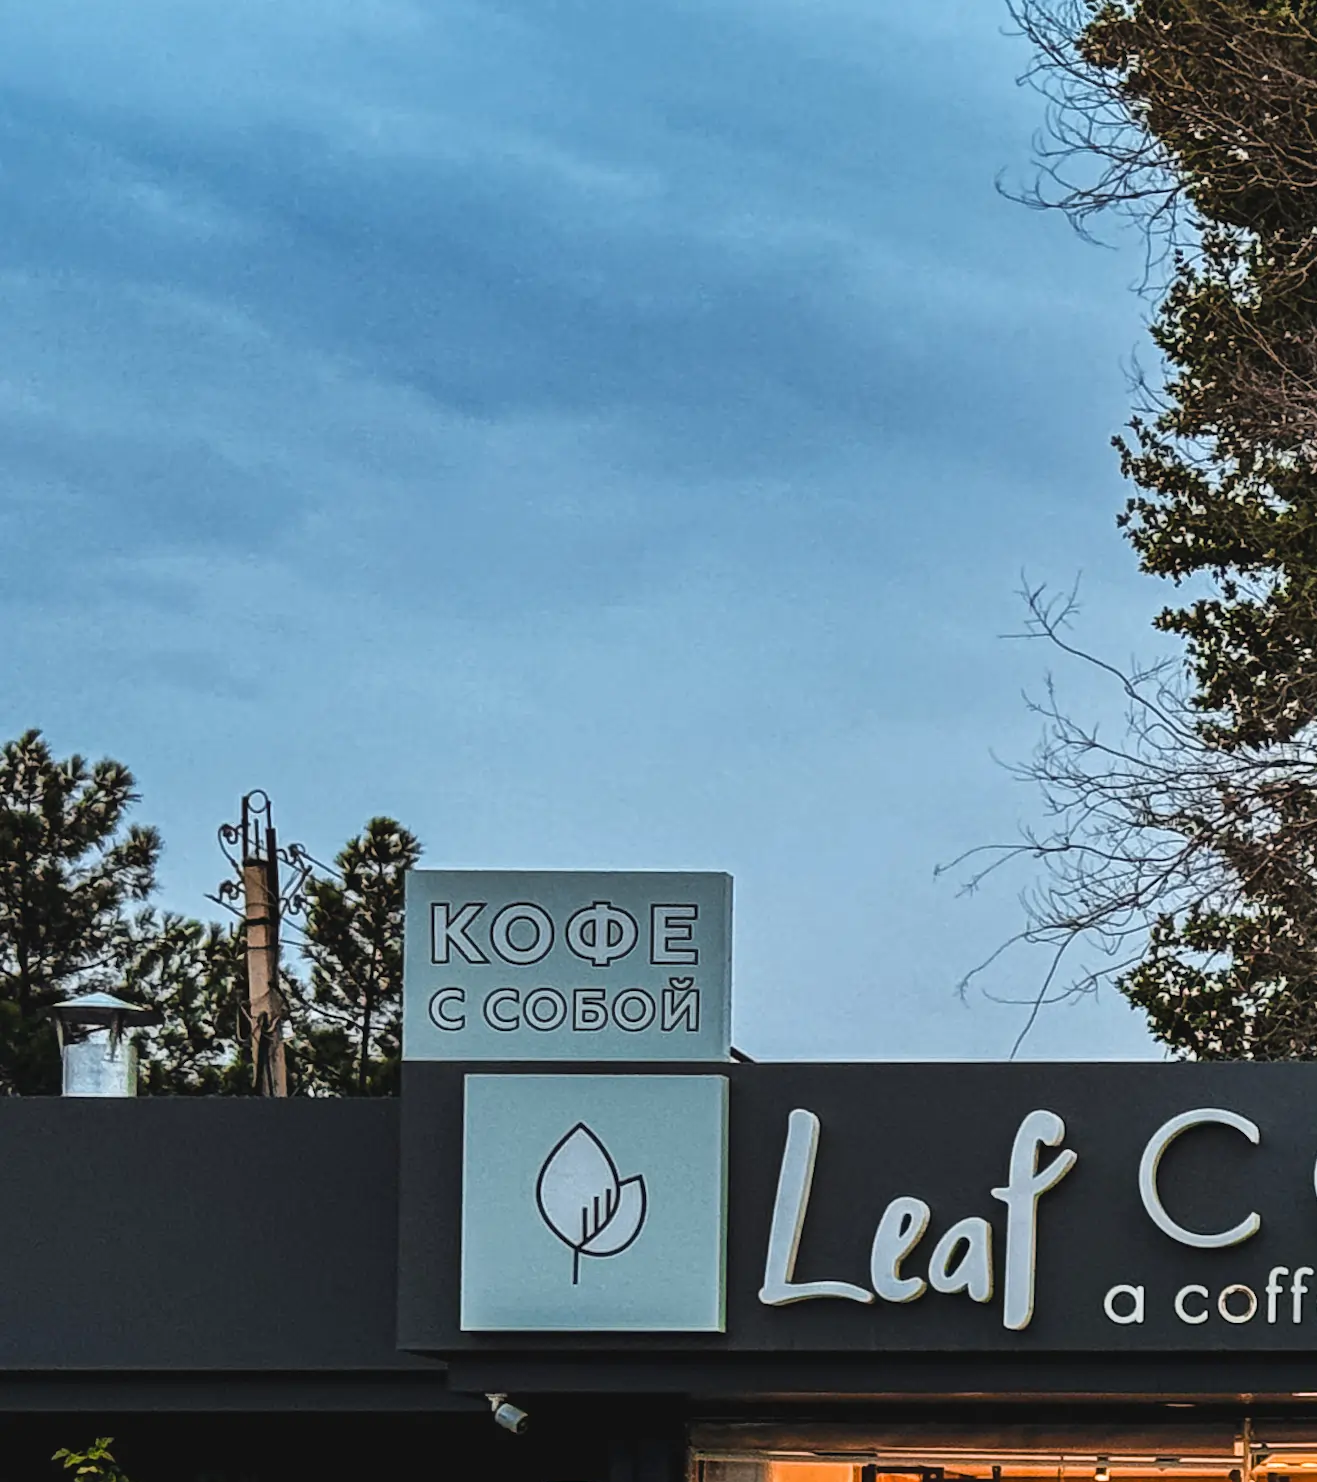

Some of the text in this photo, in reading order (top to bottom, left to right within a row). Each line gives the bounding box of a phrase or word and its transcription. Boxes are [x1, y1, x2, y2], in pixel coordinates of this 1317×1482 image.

[430, 901, 699, 966] КОФЕ
[429, 977, 700, 1032] С СОБОЙ
[758, 1108, 1078, 1331] Leaf
[1103, 1283, 1146, 1324] a
